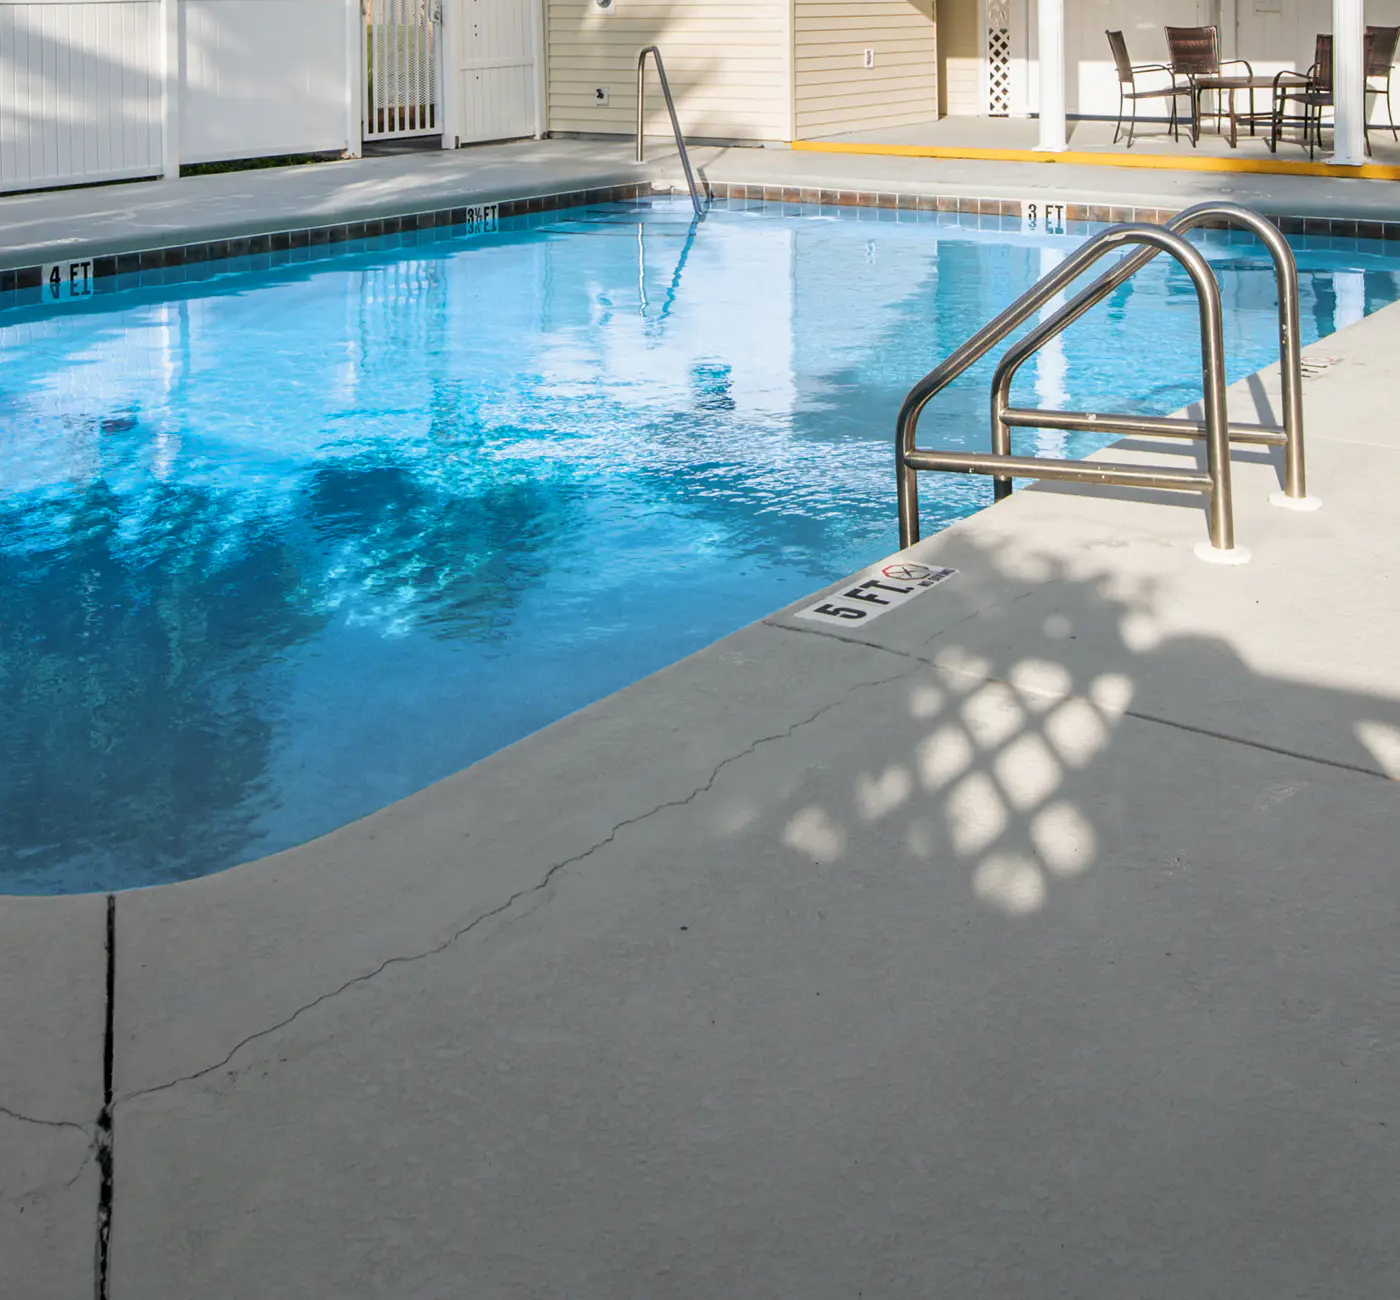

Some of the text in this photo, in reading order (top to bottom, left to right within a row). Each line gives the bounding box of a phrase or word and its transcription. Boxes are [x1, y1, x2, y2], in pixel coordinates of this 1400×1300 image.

[483, 205, 497, 221] FT
[1028, 203, 1064, 220] 3 FT
[49, 261, 91, 284] 4 FT
[813, 580, 914, 619] 5 FT.
